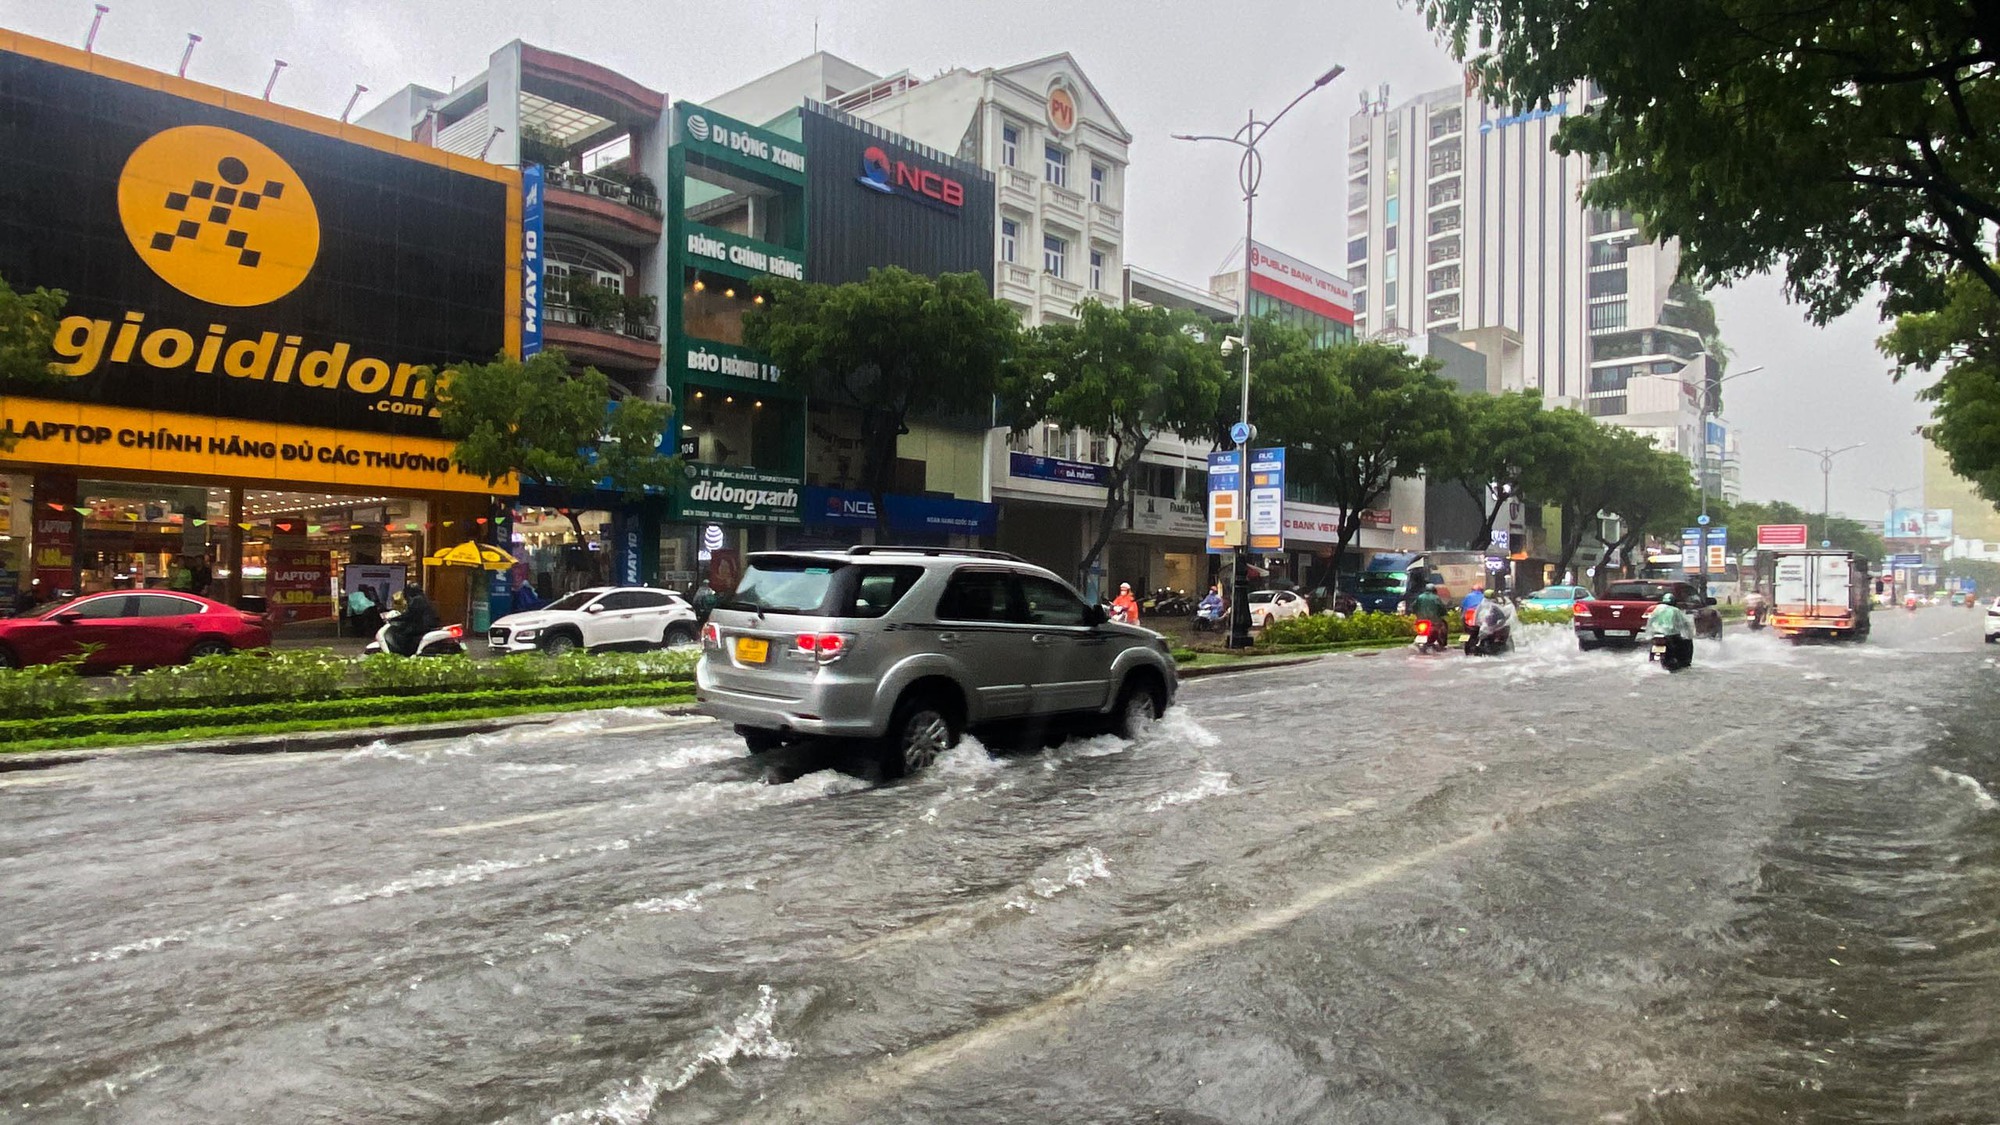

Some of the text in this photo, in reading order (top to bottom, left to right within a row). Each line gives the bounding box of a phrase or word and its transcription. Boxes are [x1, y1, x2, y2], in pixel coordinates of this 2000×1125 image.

[1051, 99, 1072, 124] PVI
[713, 124, 804, 173] DI ĐỘNG XANH
[896, 161, 964, 207] NCB
[688, 233, 803, 281] HÀNG CHÍNH HÃNG
[525, 230, 538, 333] MAY 10
[1260, 256, 1348, 298] PUBLIC BANK VIETNAM
[687, 346, 719, 373] BẢO
[721, 354, 759, 379] HÀNH
[368, 400, 422, 416] .com
[6, 419, 112, 445] LAPTOP
[118, 428, 202, 454] CHÍNH
[208, 435, 275, 458] HÃNG
[281, 440, 313, 462] ĐỦ
[318, 444, 360, 466] CÁC
[364, 450, 449, 473] THƯƠNG
[681, 443, 694, 454] 106
[690, 480, 798, 510] didongxanh
[1293, 520, 1315, 531] BANK
[274, 571, 320, 581] LAPTOP
[627, 552, 638, 583] MAY
